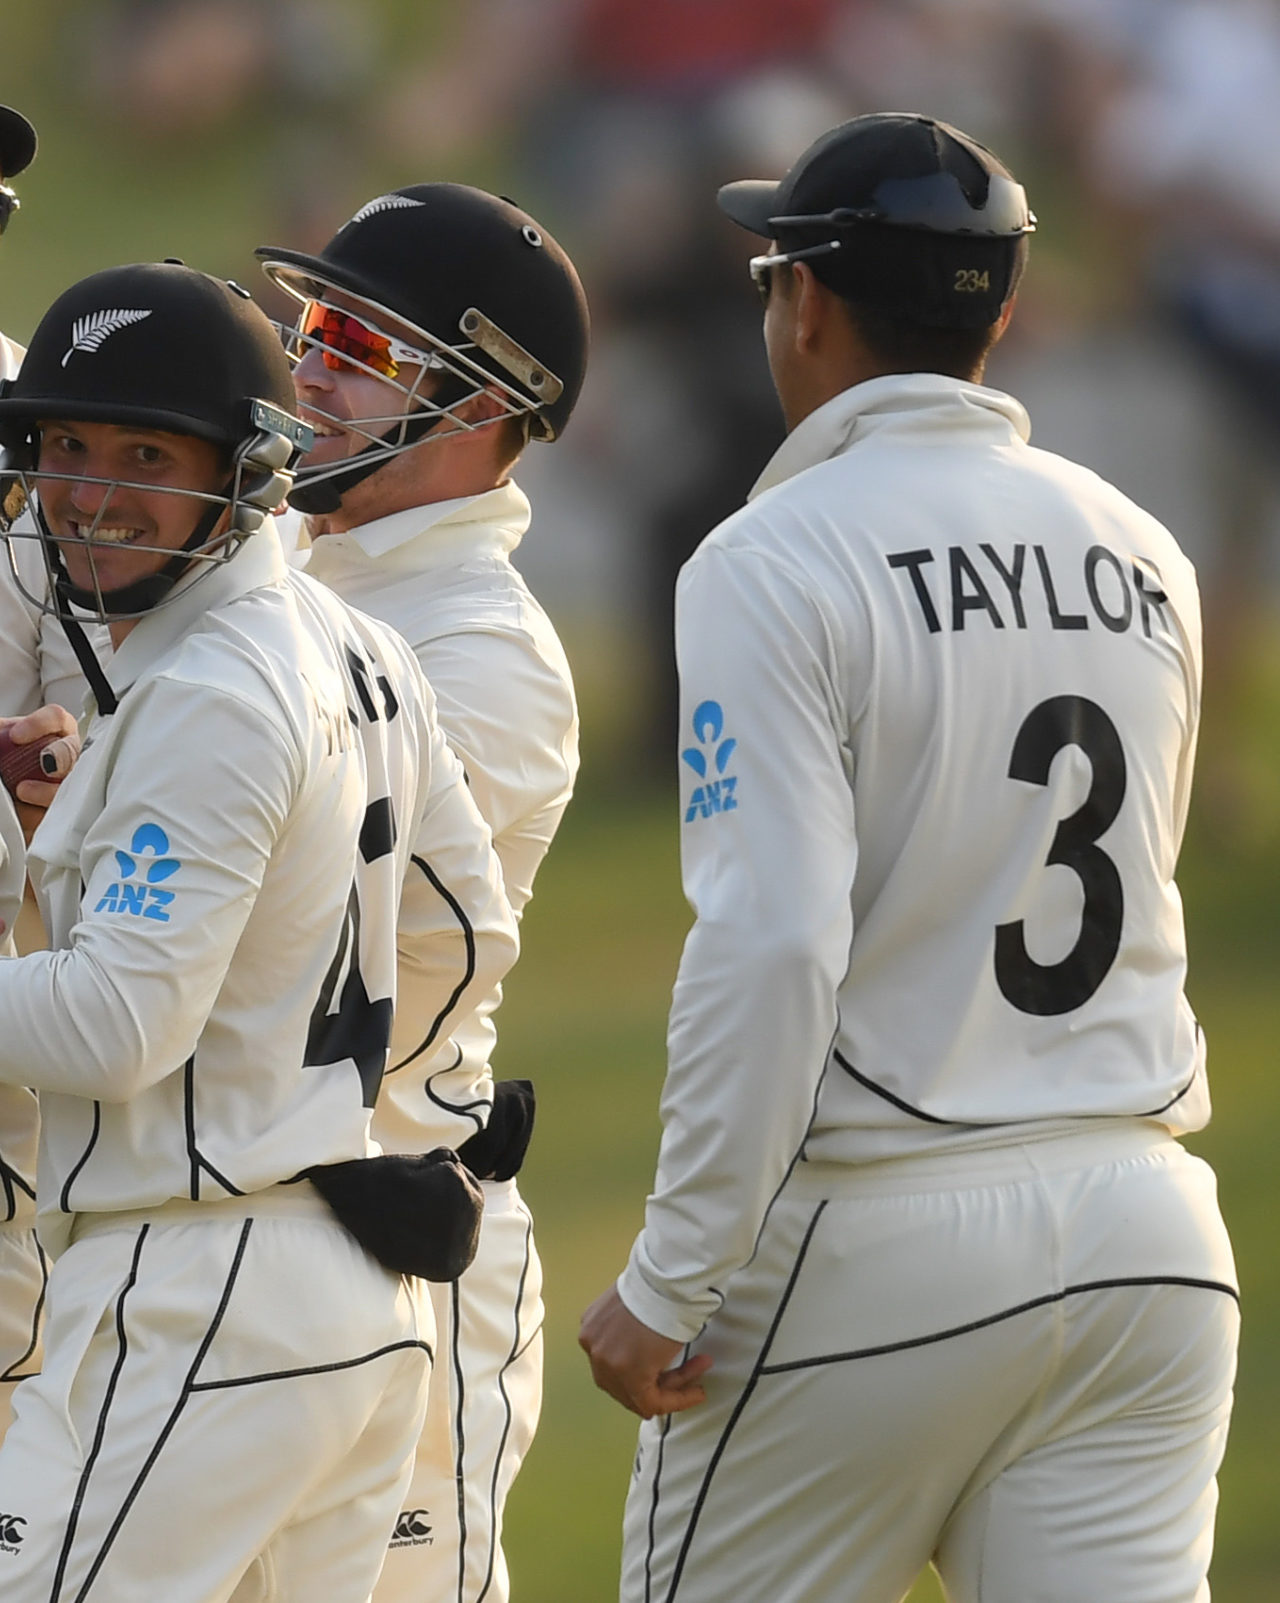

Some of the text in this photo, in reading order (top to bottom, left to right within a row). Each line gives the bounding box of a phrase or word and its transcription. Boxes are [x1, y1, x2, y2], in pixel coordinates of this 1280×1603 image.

[954, 269, 989, 292] 234
[886, 543, 1170, 639] TAYLOR
[685, 776, 738, 823] ANZ
[993, 694, 1127, 1017] 3
[94, 883, 176, 922] ANZ
[388, 1537, 434, 1549] anterbury
